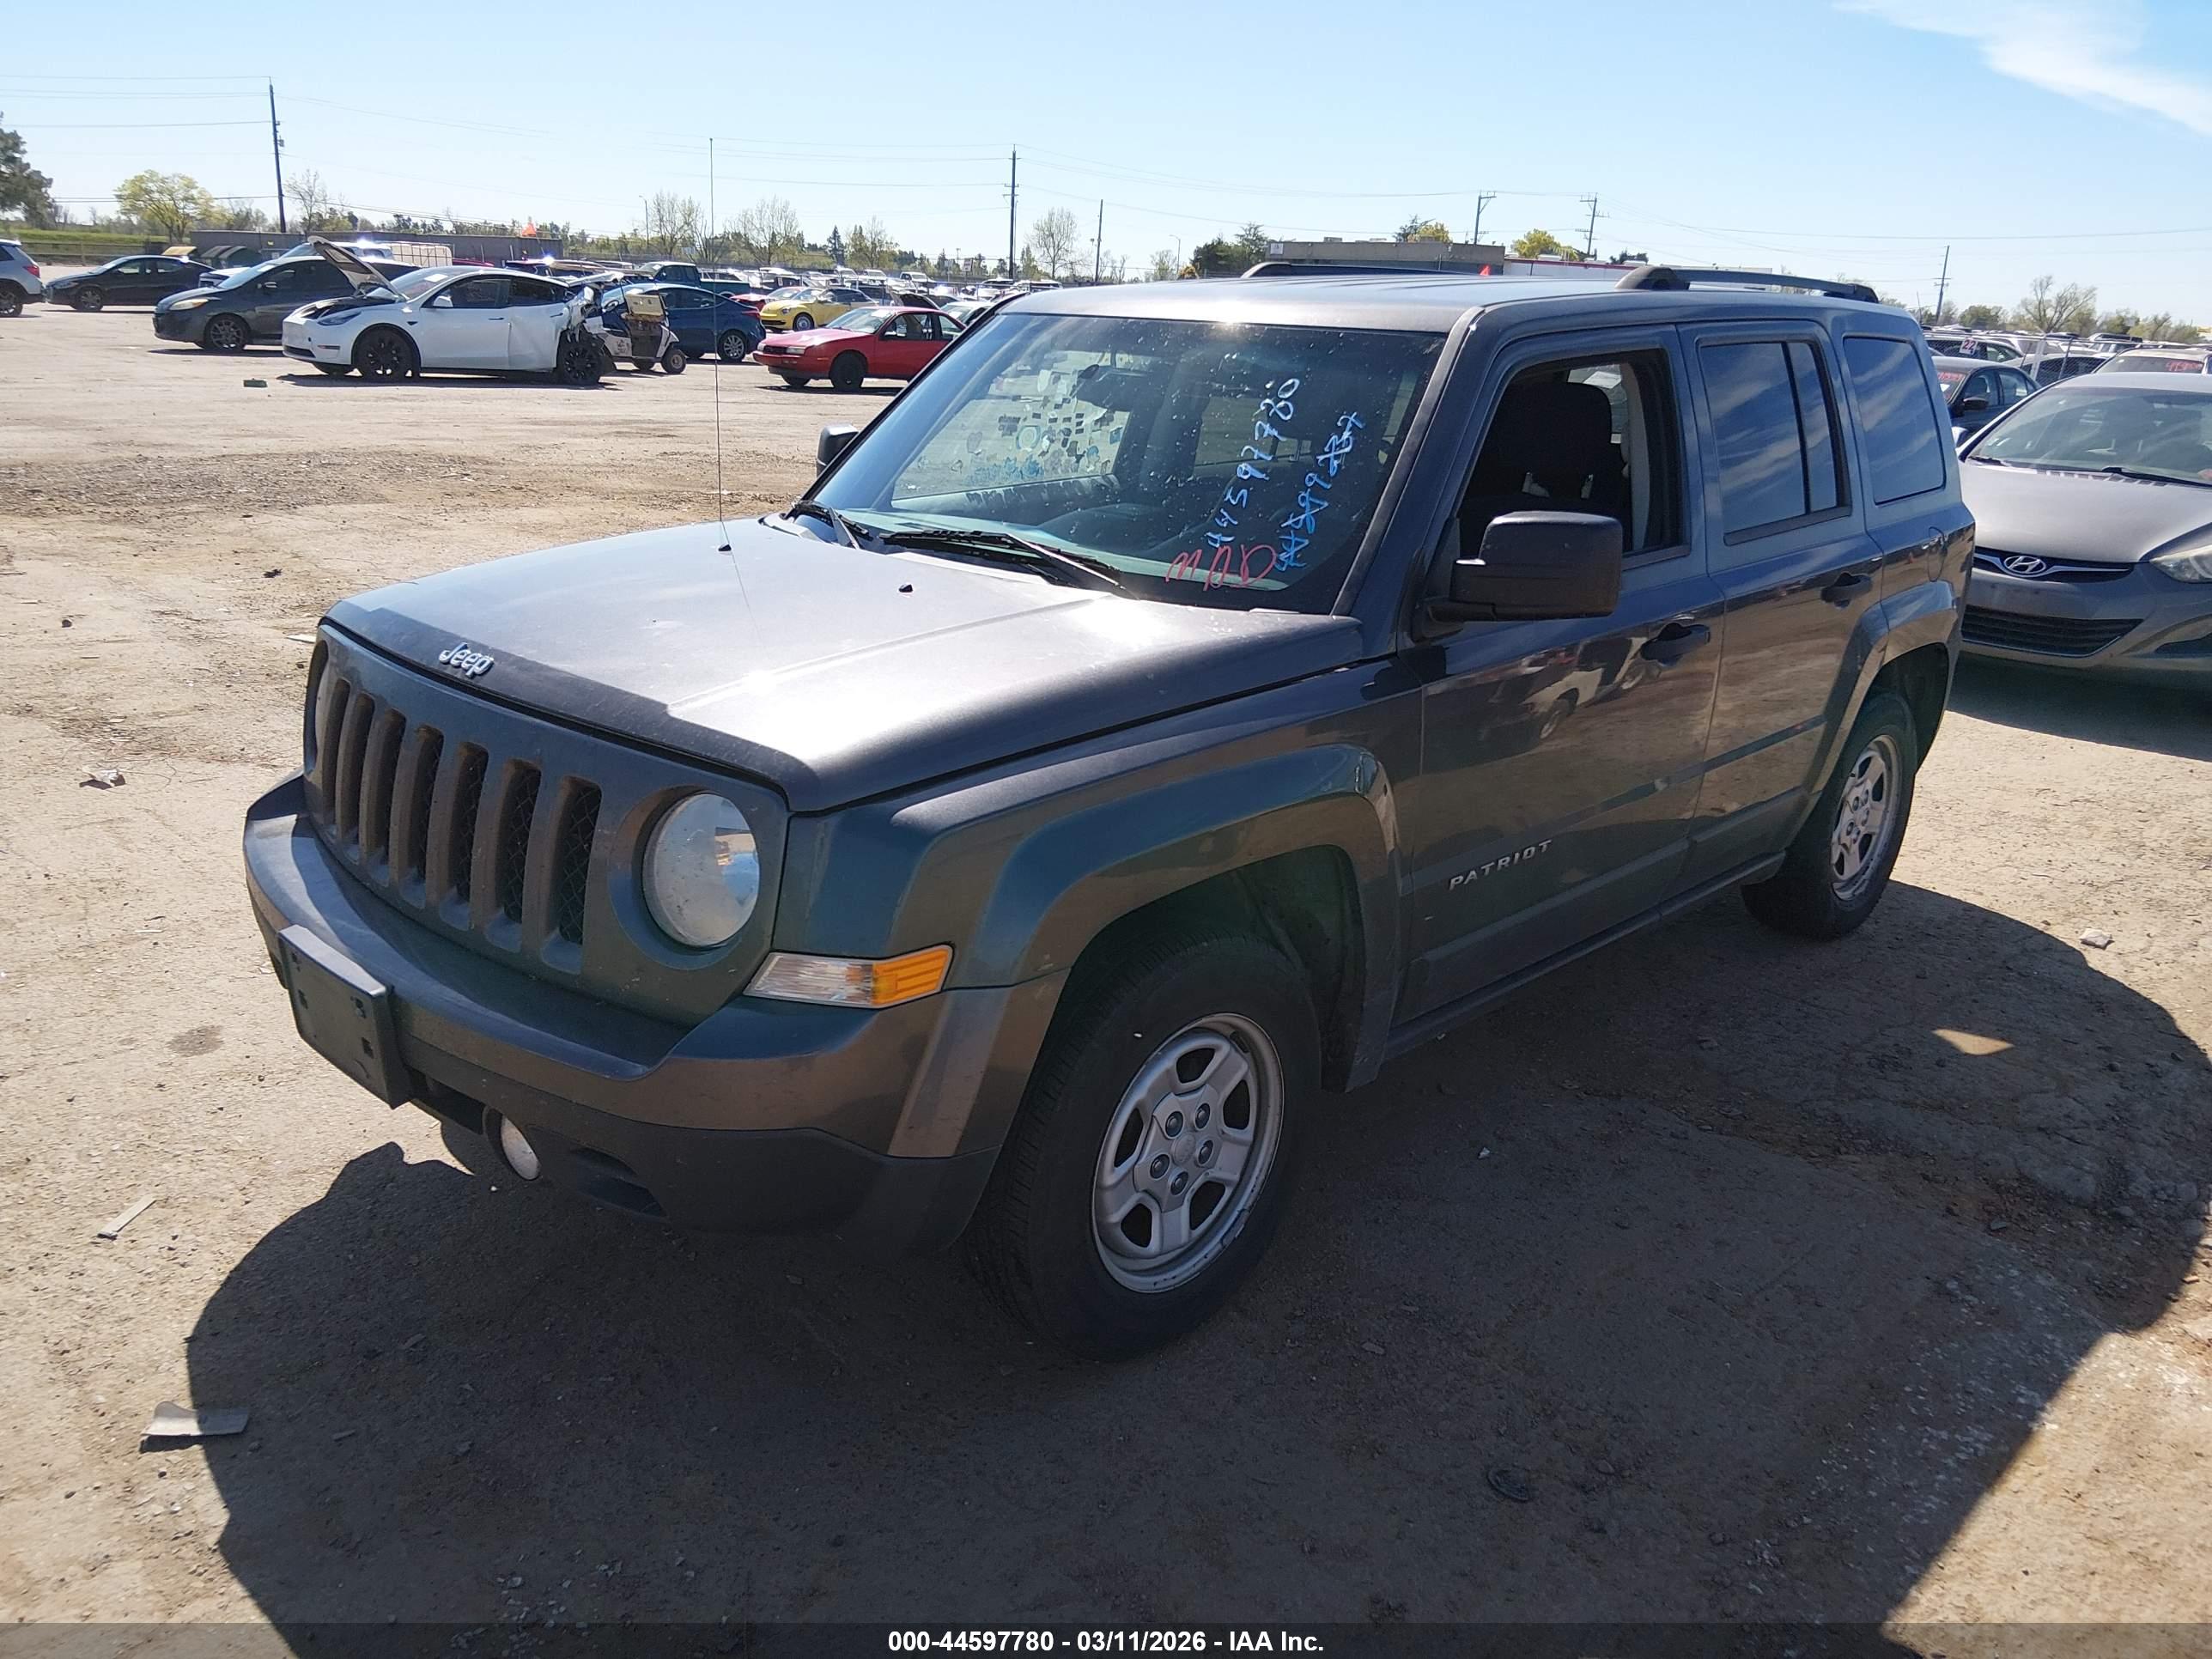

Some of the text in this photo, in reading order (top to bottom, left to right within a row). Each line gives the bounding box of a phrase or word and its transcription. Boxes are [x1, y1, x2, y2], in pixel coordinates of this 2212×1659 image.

[1204, 378, 1300, 548] 44597780
[438, 641, 495, 678] Jeep
[1449, 839, 1553, 890] PATRIOT
